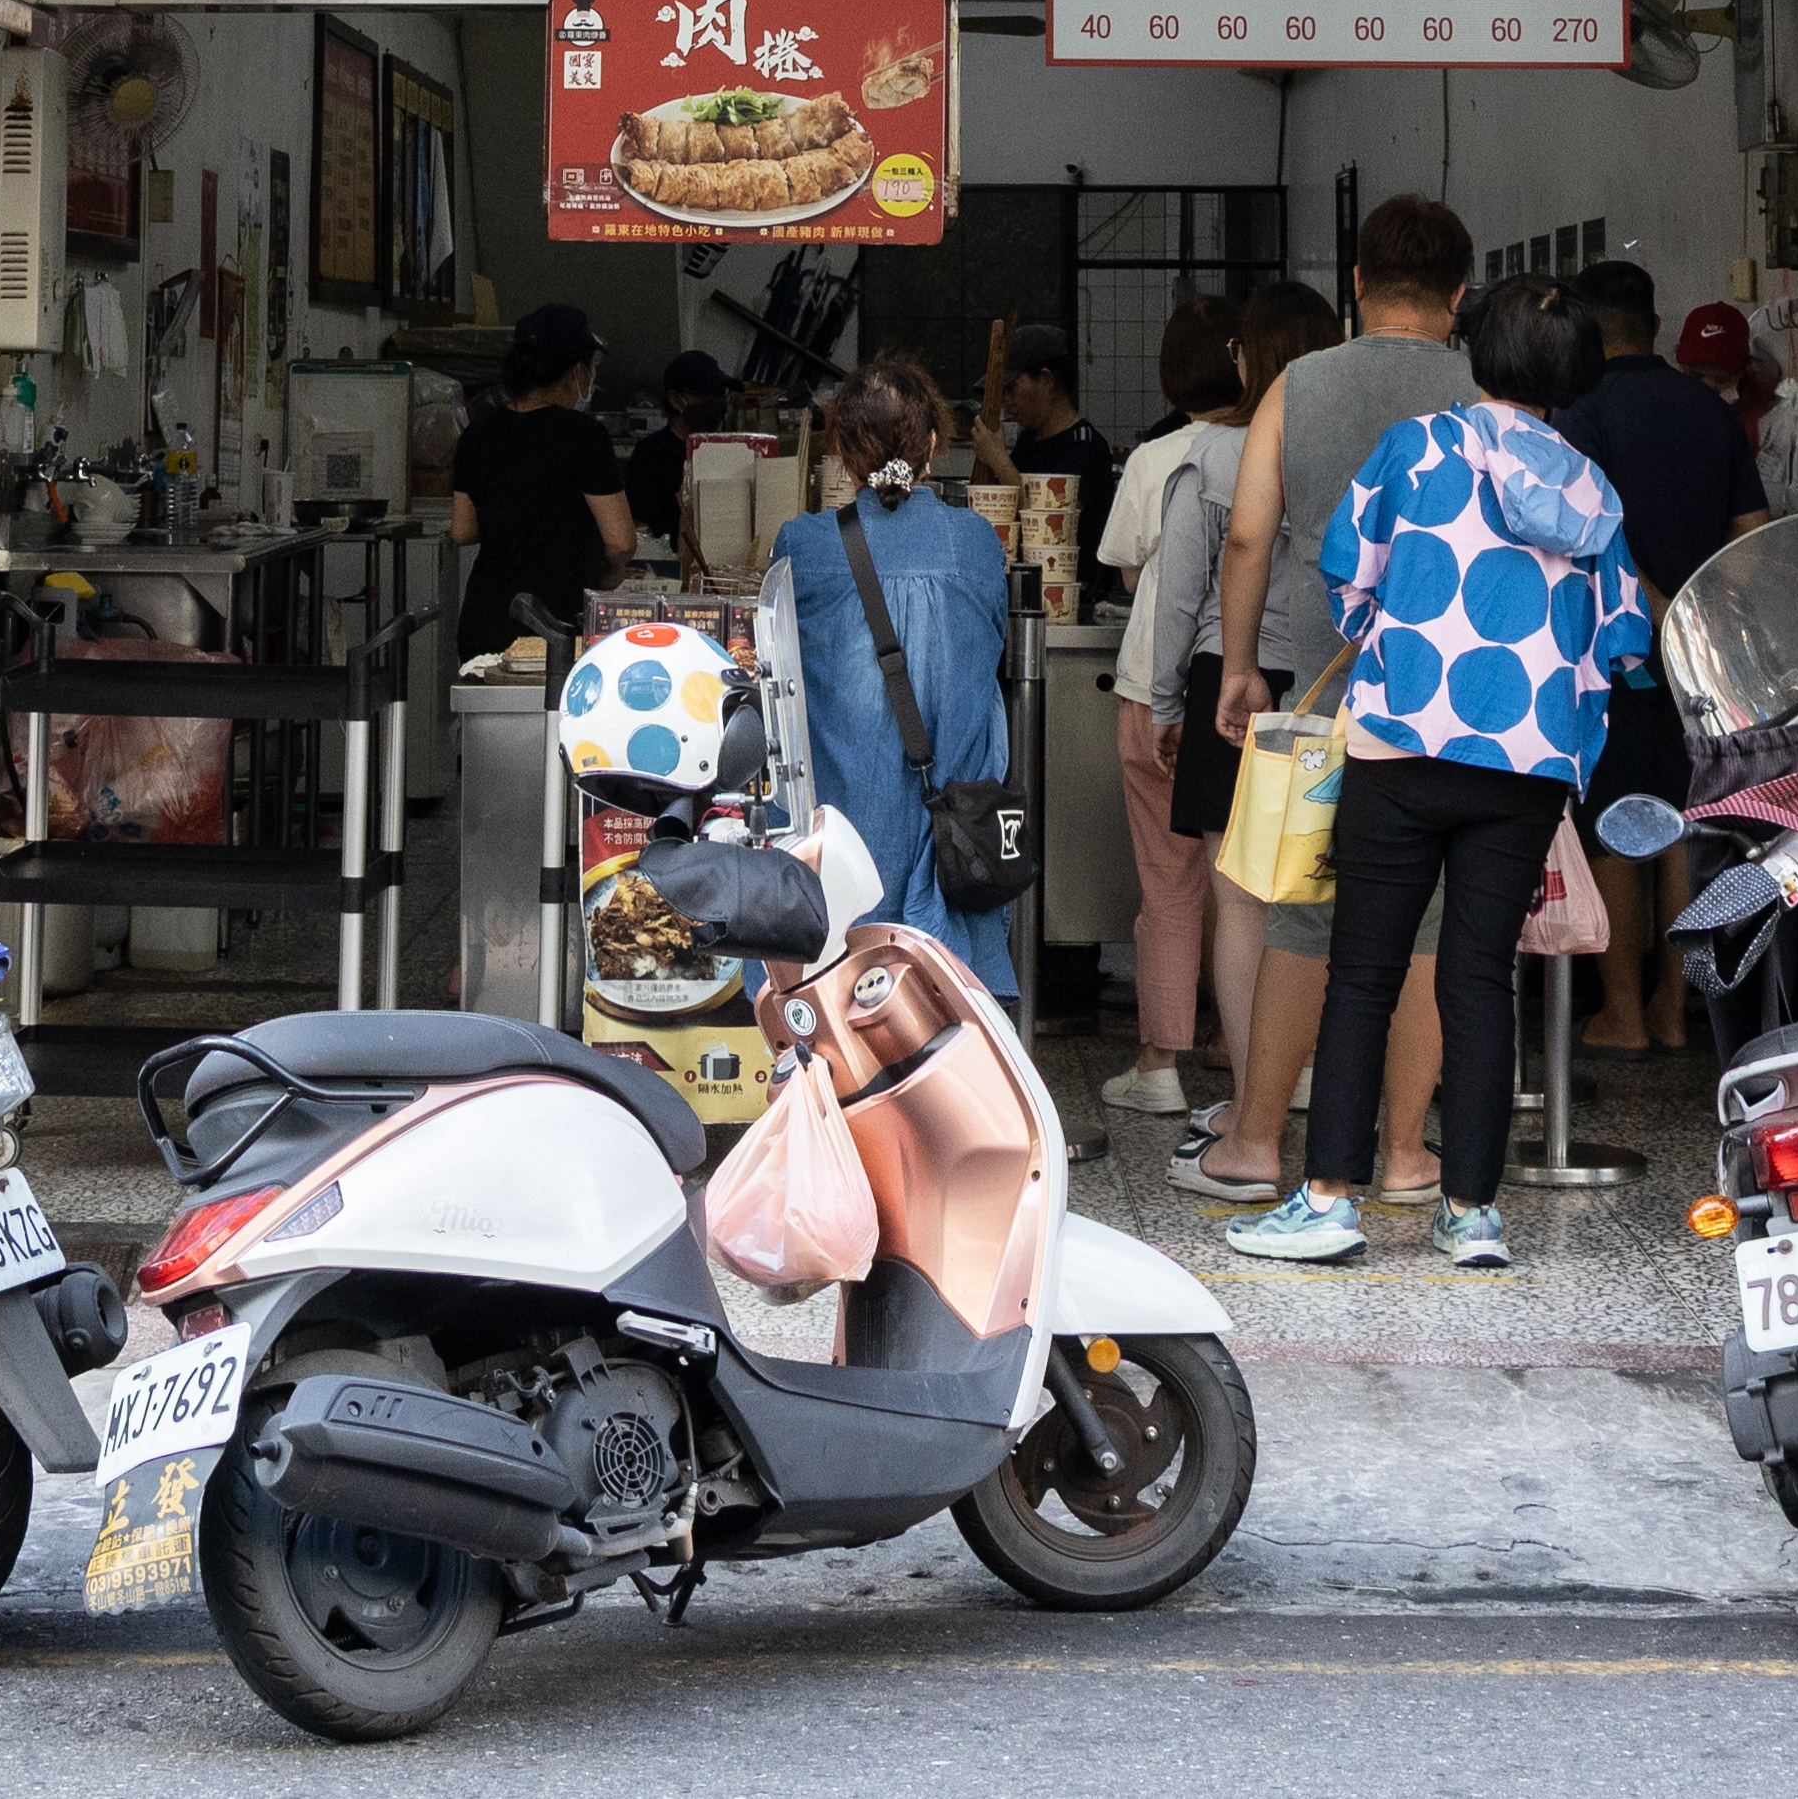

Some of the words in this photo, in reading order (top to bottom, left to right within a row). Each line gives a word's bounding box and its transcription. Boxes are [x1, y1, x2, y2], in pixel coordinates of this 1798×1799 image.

[1080, 13, 1112, 40] 40
[1148, 14, 1180, 40] 60
[1216, 15, 1248, 41] 60
[1285, 15, 1316, 41] 60
[1353, 16, 1385, 41] 60
[1421, 16, 1453, 42] 60
[1490, 16, 1522, 42] 60
[1551, 17, 1599, 43] 270
[604, 223, 711, 238] 羅東在地特色小吃
[697, 1082, 744, 1096] 隔水加熱
